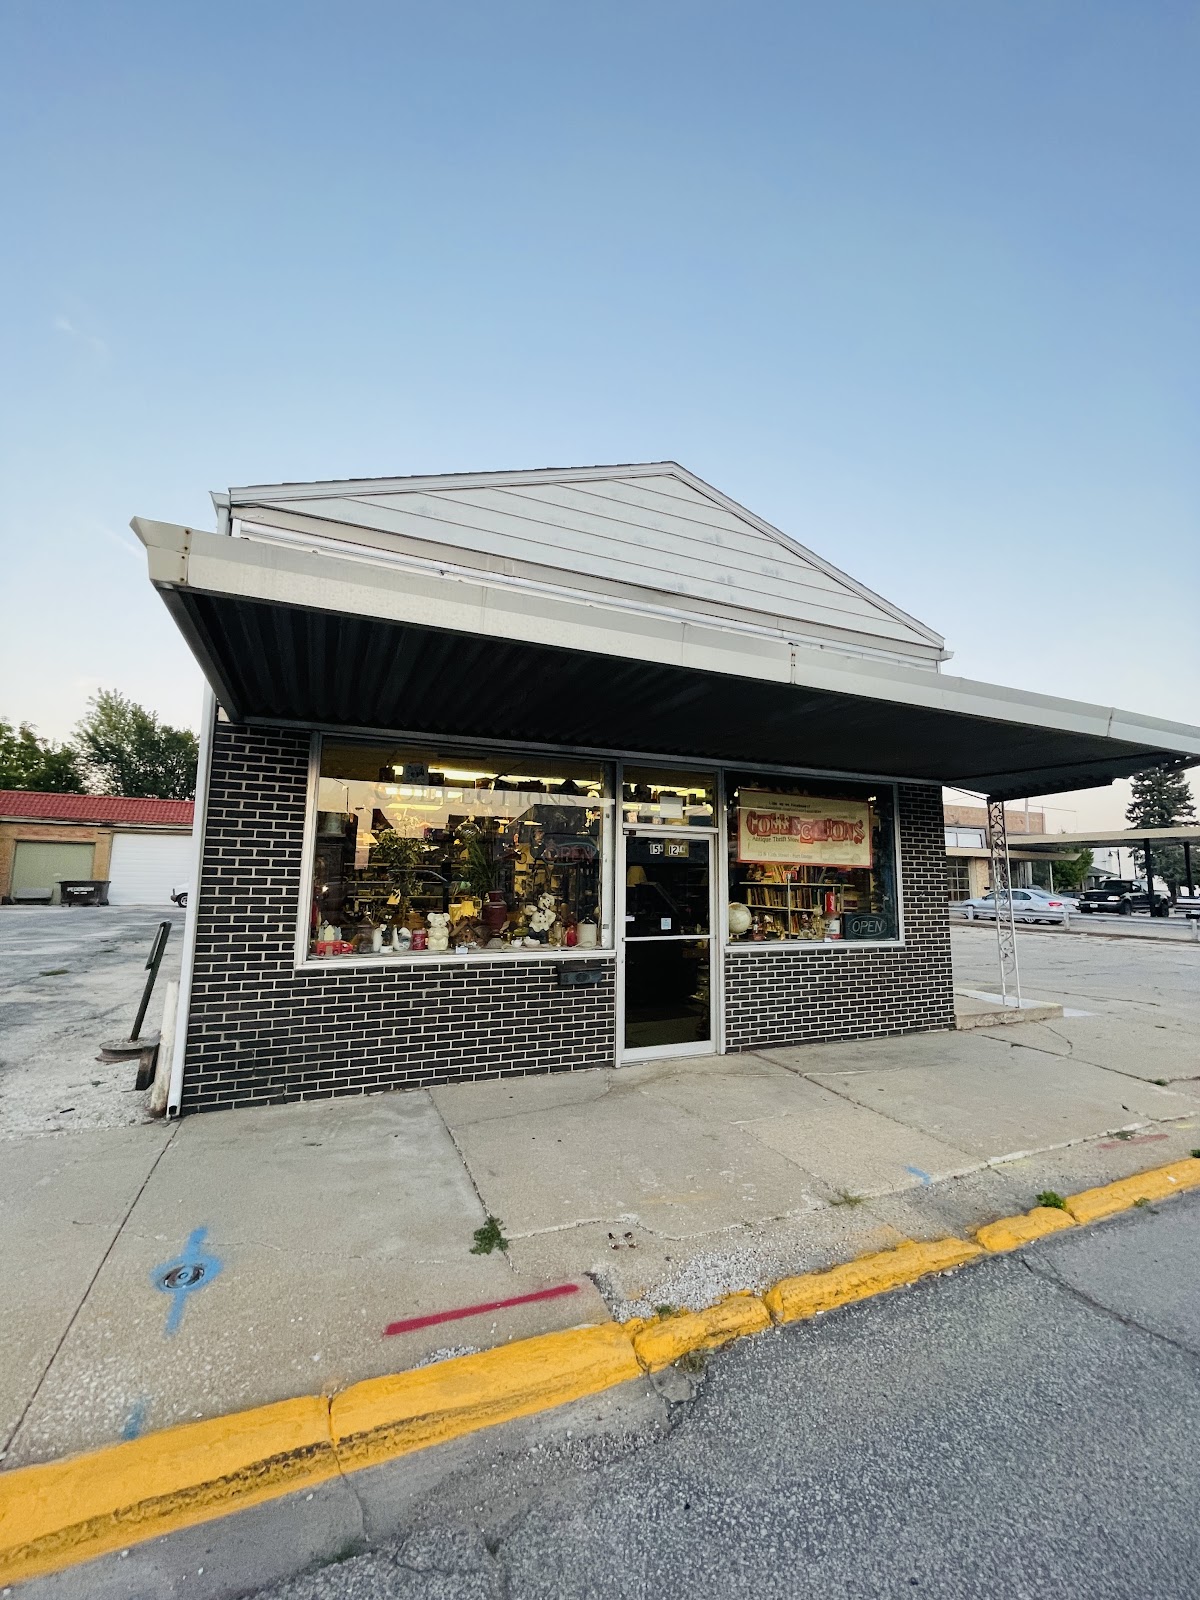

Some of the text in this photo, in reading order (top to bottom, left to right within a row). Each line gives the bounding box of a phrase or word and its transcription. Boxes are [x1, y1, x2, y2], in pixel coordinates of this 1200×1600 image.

[373, 783, 577, 807] COLLECTIONS
[543, 846, 593, 864] OPEN
[852, 920, 883, 933] OPEN
